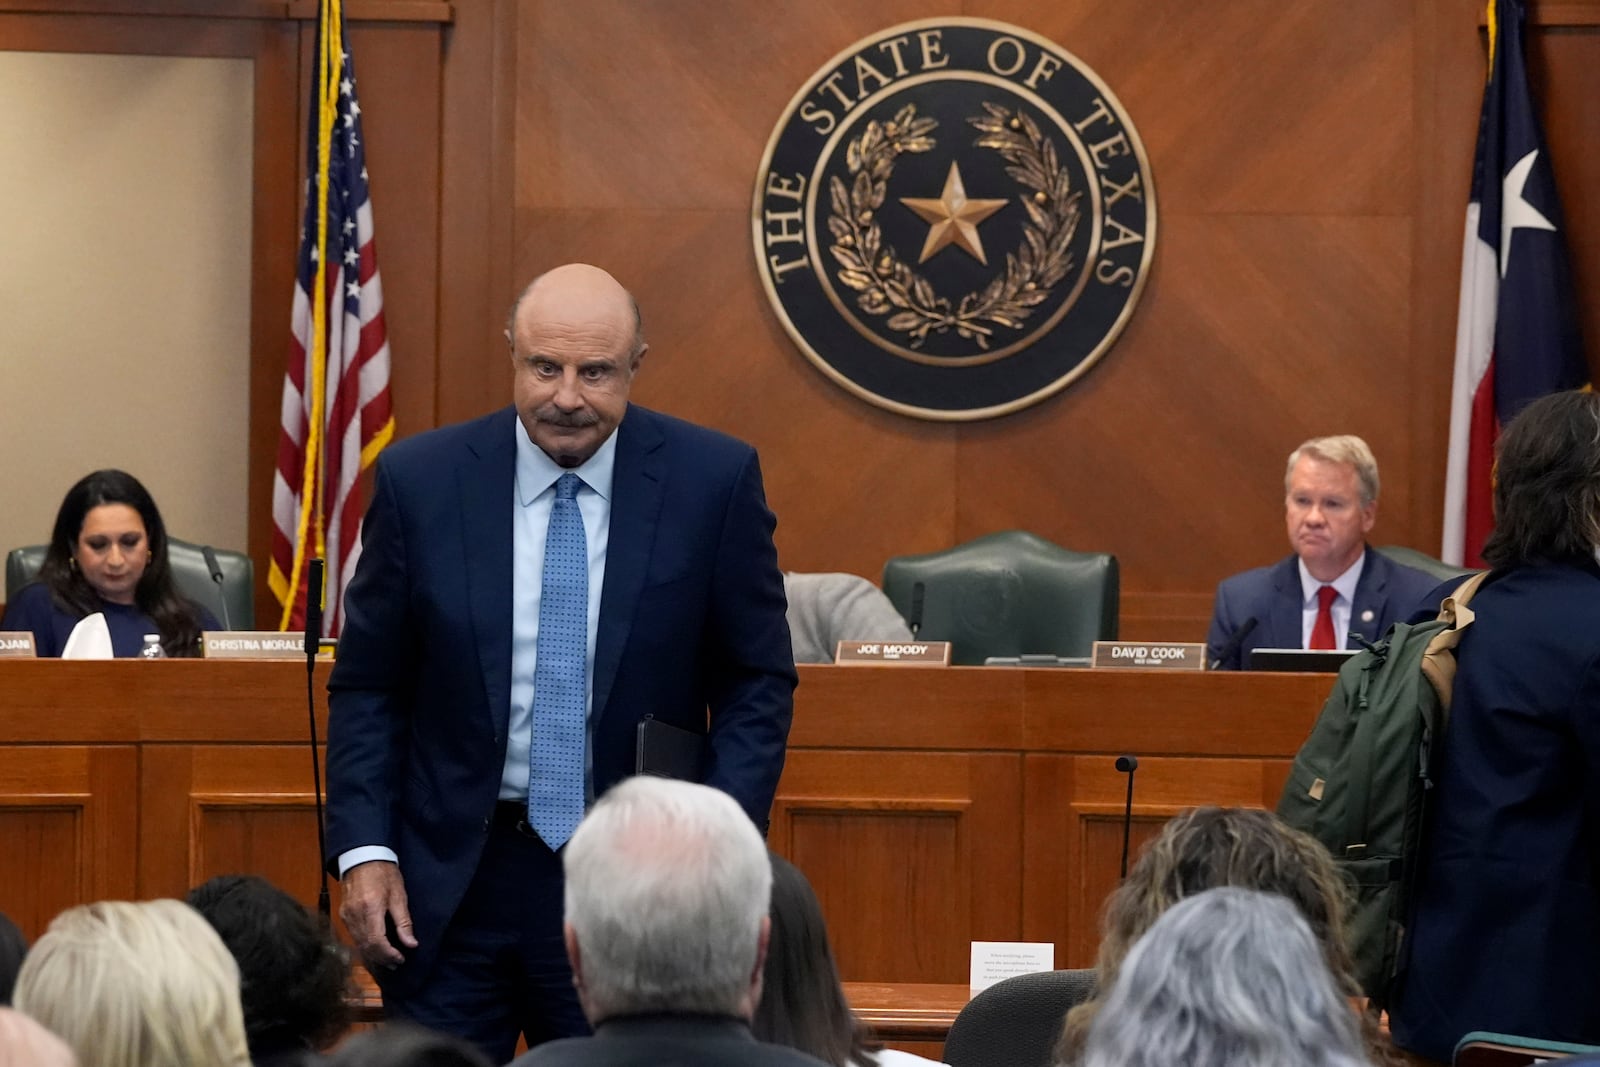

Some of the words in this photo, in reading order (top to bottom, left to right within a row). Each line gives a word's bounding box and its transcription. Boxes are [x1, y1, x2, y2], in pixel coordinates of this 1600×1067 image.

[766, 172, 808, 283] THE
[799, 29, 950, 134] STATE
[987, 36, 1062, 90] OF
[1073, 98, 1144, 288] TEXAS
[209, 639, 260, 650] CHRISTINA
[262, 639, 305, 650] MORALE
[857, 644, 880, 654] JOE
[883, 645, 928, 655] MOODY
[1111, 646, 1147, 658] DAVID
[1151, 647, 1185, 659] COOK
